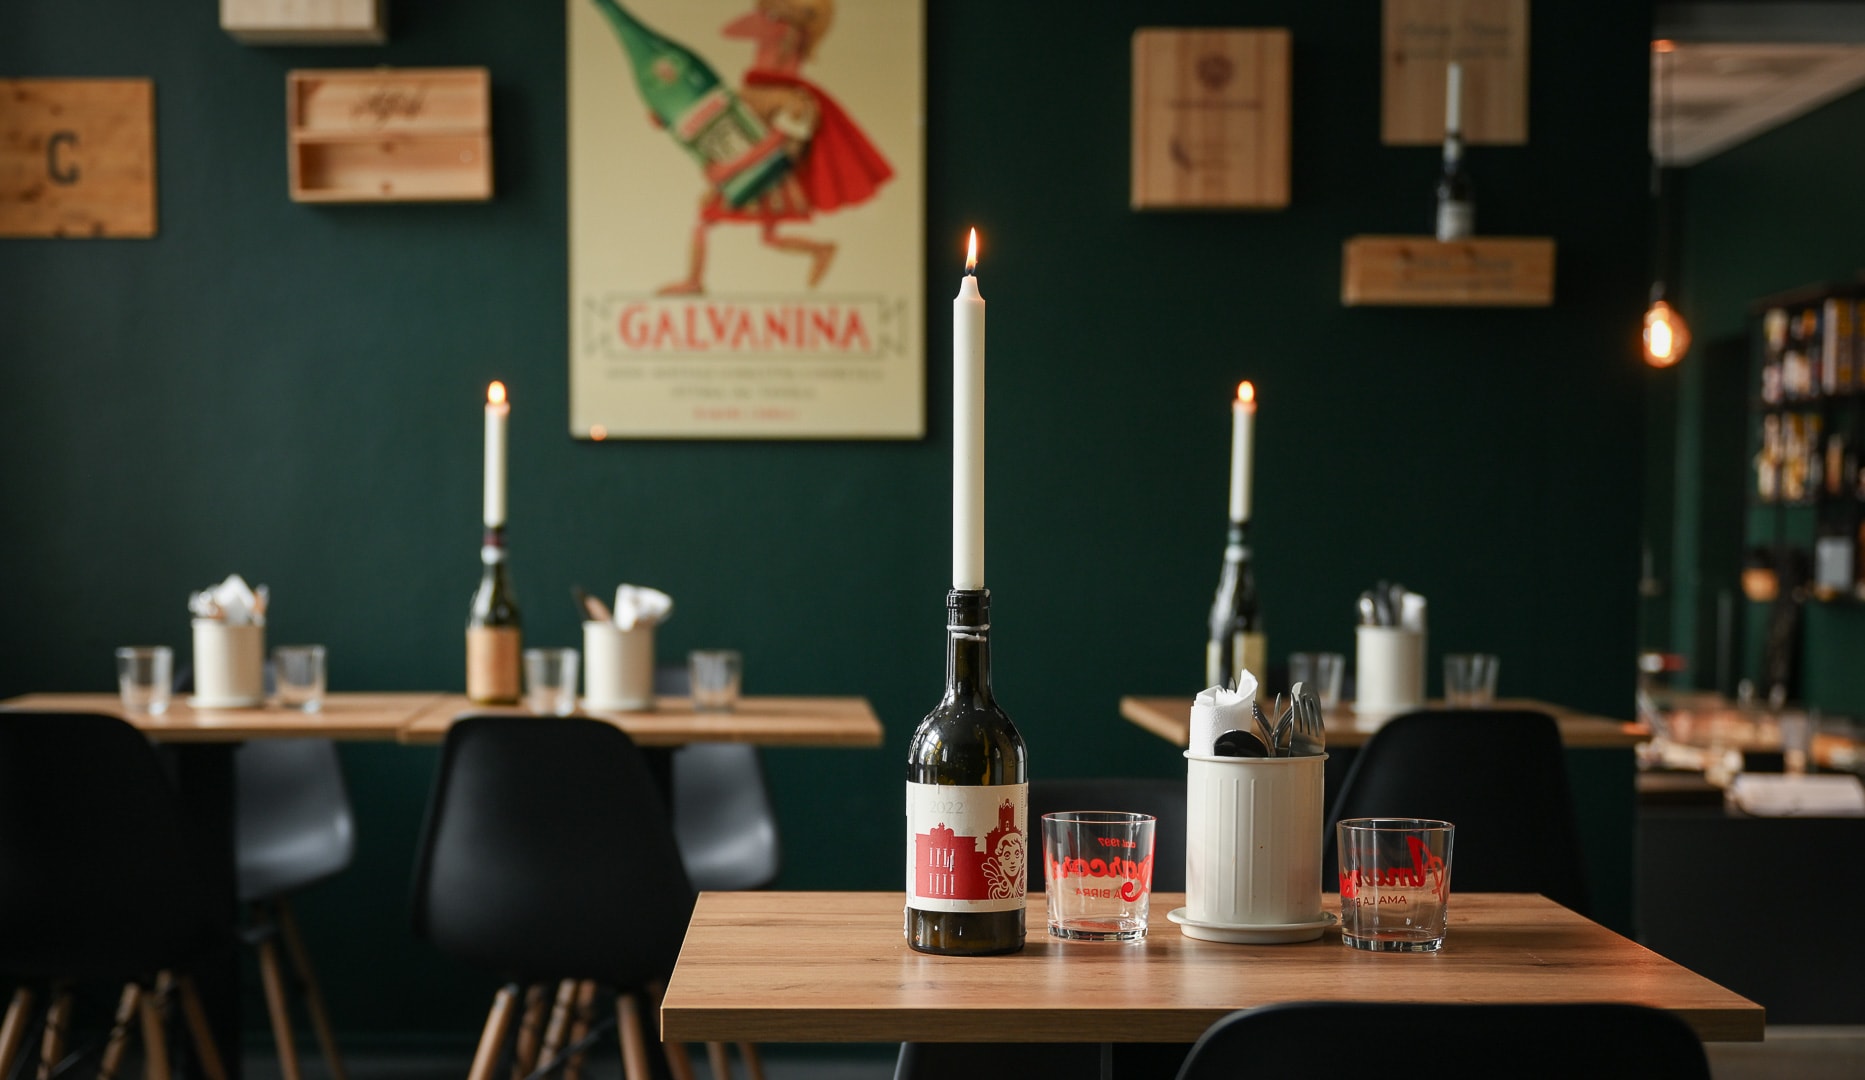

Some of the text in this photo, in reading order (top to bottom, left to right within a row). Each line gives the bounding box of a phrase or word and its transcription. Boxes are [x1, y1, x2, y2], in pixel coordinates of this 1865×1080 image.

[47, 130, 81, 187] C
[617, 302, 872, 352] GALVANINA
[929, 801, 964, 815] 2022
